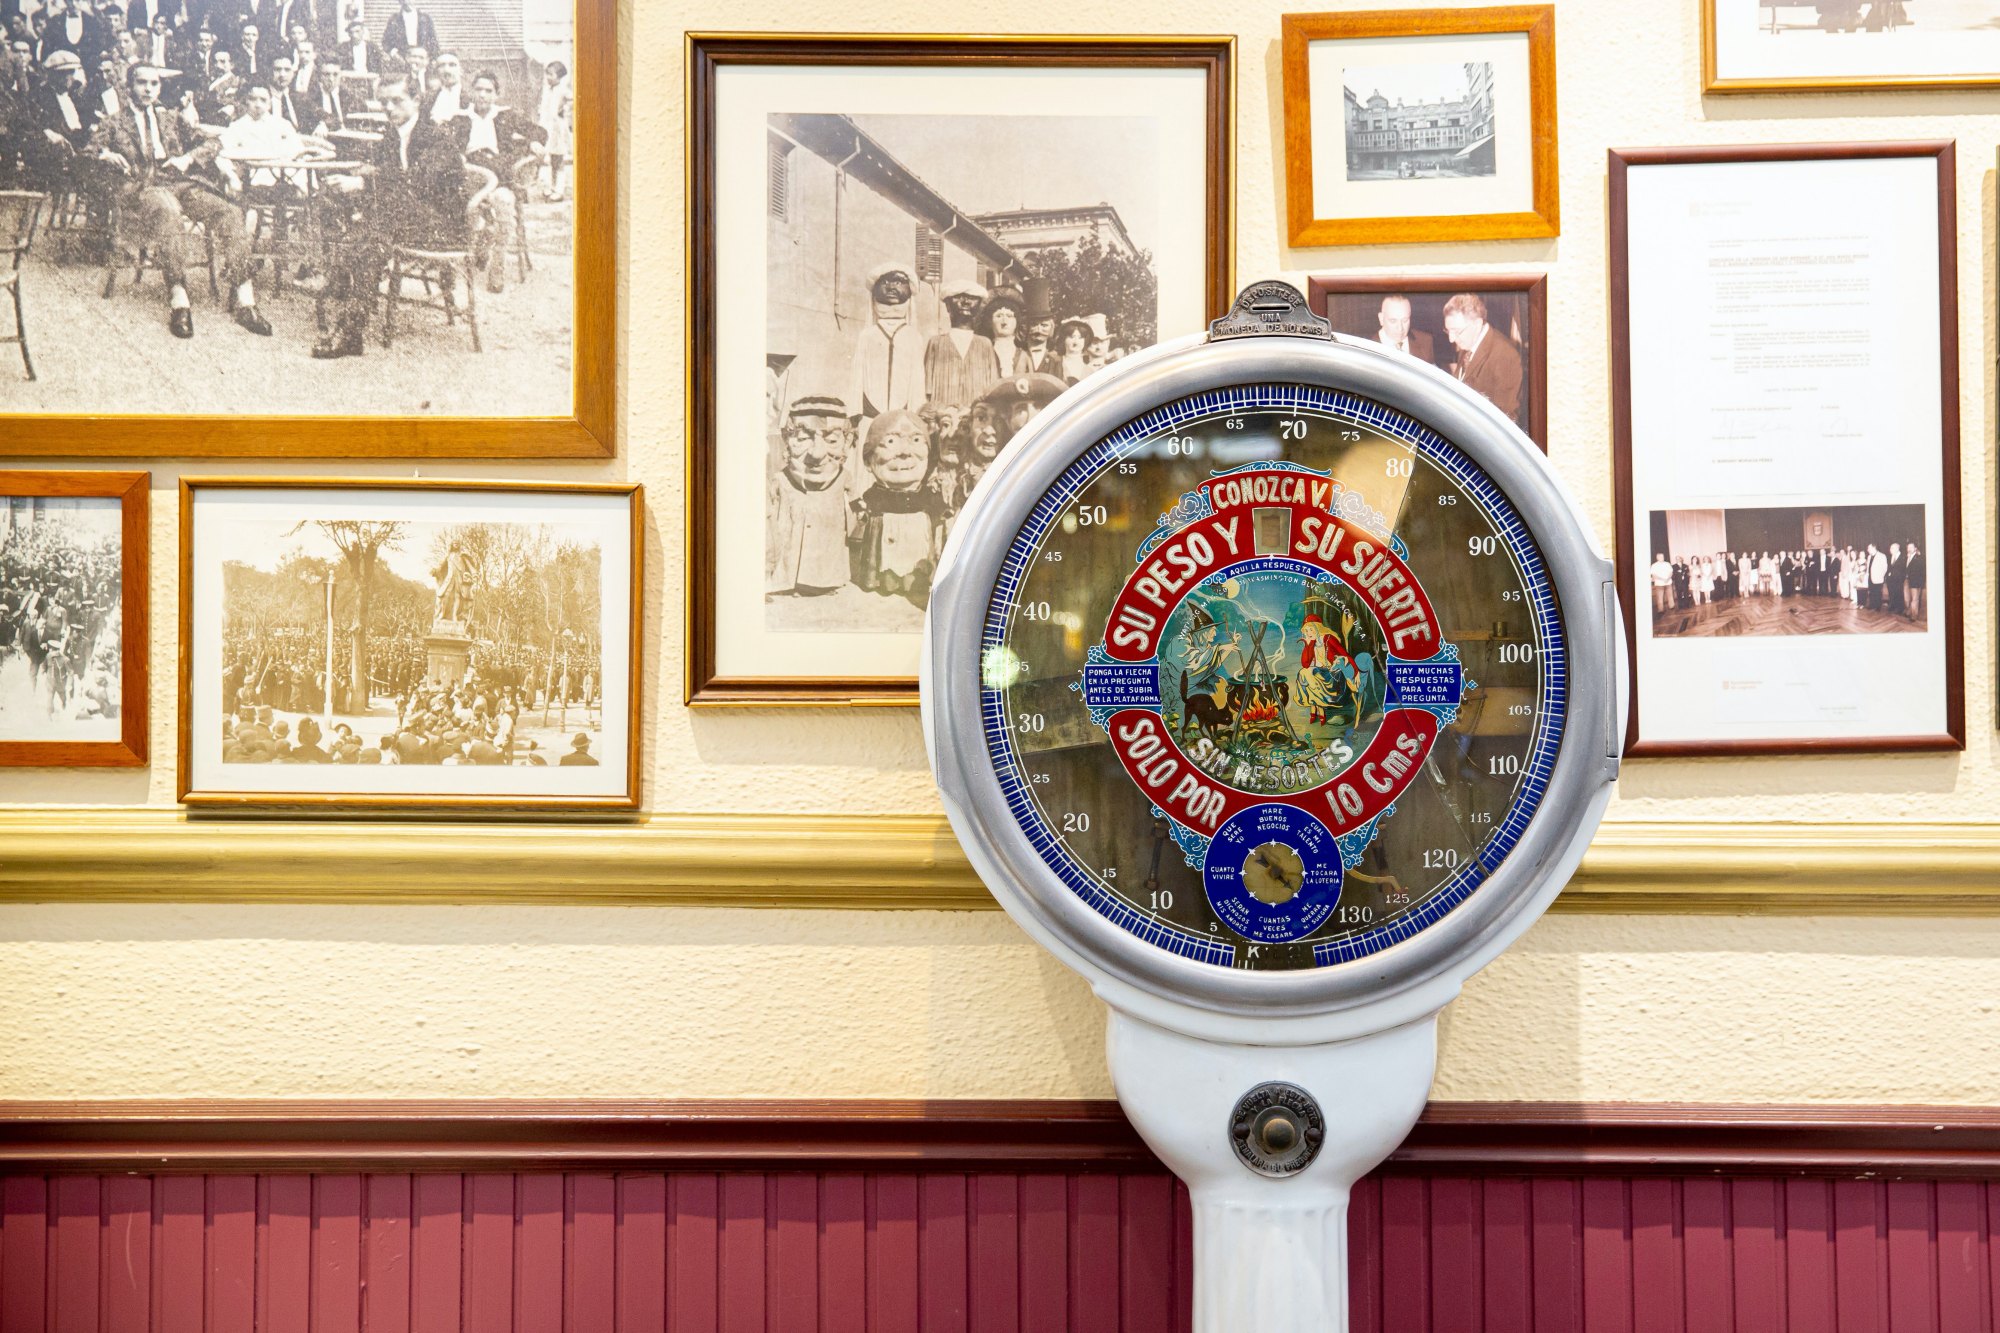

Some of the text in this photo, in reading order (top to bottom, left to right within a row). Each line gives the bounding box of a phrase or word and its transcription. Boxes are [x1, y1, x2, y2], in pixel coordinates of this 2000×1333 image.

[1260, 313, 1282, 322] UNA
[1219, 324, 1260, 336] MONEDA
[1266, 324, 1281, 334] DE
[1225, 418, 1244, 430] 65
[1279, 419, 1308, 440] 70
[1341, 431, 1361, 442] 75
[1167, 436, 1194, 455] 60
[1119, 463, 1137, 475] 55
[1385, 458, 1413, 477] 80
[1213, 476, 1306, 509] CONOZCA
[1438, 495, 1457, 506] 85
[1079, 505, 1107, 526] 50
[1468, 536, 1496, 556] 90
[1044, 551, 1063, 562] 45
[1230, 561, 1312, 576] AQUI LA RESPUESTA
[1112, 516, 1432, 653] SU PESO Y SU SUERTE
[1502, 590, 1521, 602] 95
[1023, 601, 1051, 621] 40
[1498, 643, 1533, 663] 100
[1395, 667, 1454, 675] HAY MUCHAS
[1110, 677, 1151, 685] PREGUNTA
[1395, 676, 1455, 684] RESPUESTAS
[1128, 686, 1153, 694] SUBIR
[1508, 705, 1532, 716] 105
[1019, 713, 1045, 733] 30
[1187, 737, 1354, 790] SIN RESORTES
[1488, 755, 1519, 775] 110
[1032, 774, 1050, 784] 25
[1118, 717, 1179, 788] SOLO
[1166, 772, 1227, 829] POR
[1324, 783, 1364, 825] 10
[1063, 812, 1090, 832] 20
[1259, 815, 1287, 823] BUENOS
[1470, 812, 1491, 823] 115
[1222, 822, 1237, 837] QUE
[1227, 826, 1243, 843] SERE
[1257, 822, 1290, 832] NEGOCIOS
[1310, 822, 1324, 836] CUAL
[1235, 835, 1245, 844] YO
[1296, 829, 1319, 854] TALENTO
[1303, 826, 1321, 844] ES MI
[1422, 848, 1457, 868] 120
[1102, 868, 1117, 878] 15
[1150, 890, 1174, 910] 10
[1231, 897, 1250, 915] SERAN
[1385, 893, 1410, 904] 125
[1223, 899, 1250, 925] DICHOSOS
[1300, 904, 1322, 923] QUERRA
[1301, 902, 1312, 913] ME
[1311, 904, 1330, 925] SUEGRA
[1338, 906, 1373, 924] 130
[1216, 900, 1248, 932] MIS AMORES
[1258, 915, 1291, 924] CUANTAS
[1210, 922, 1218, 932] 5
[1252, 930, 1294, 939] ME CASARE
